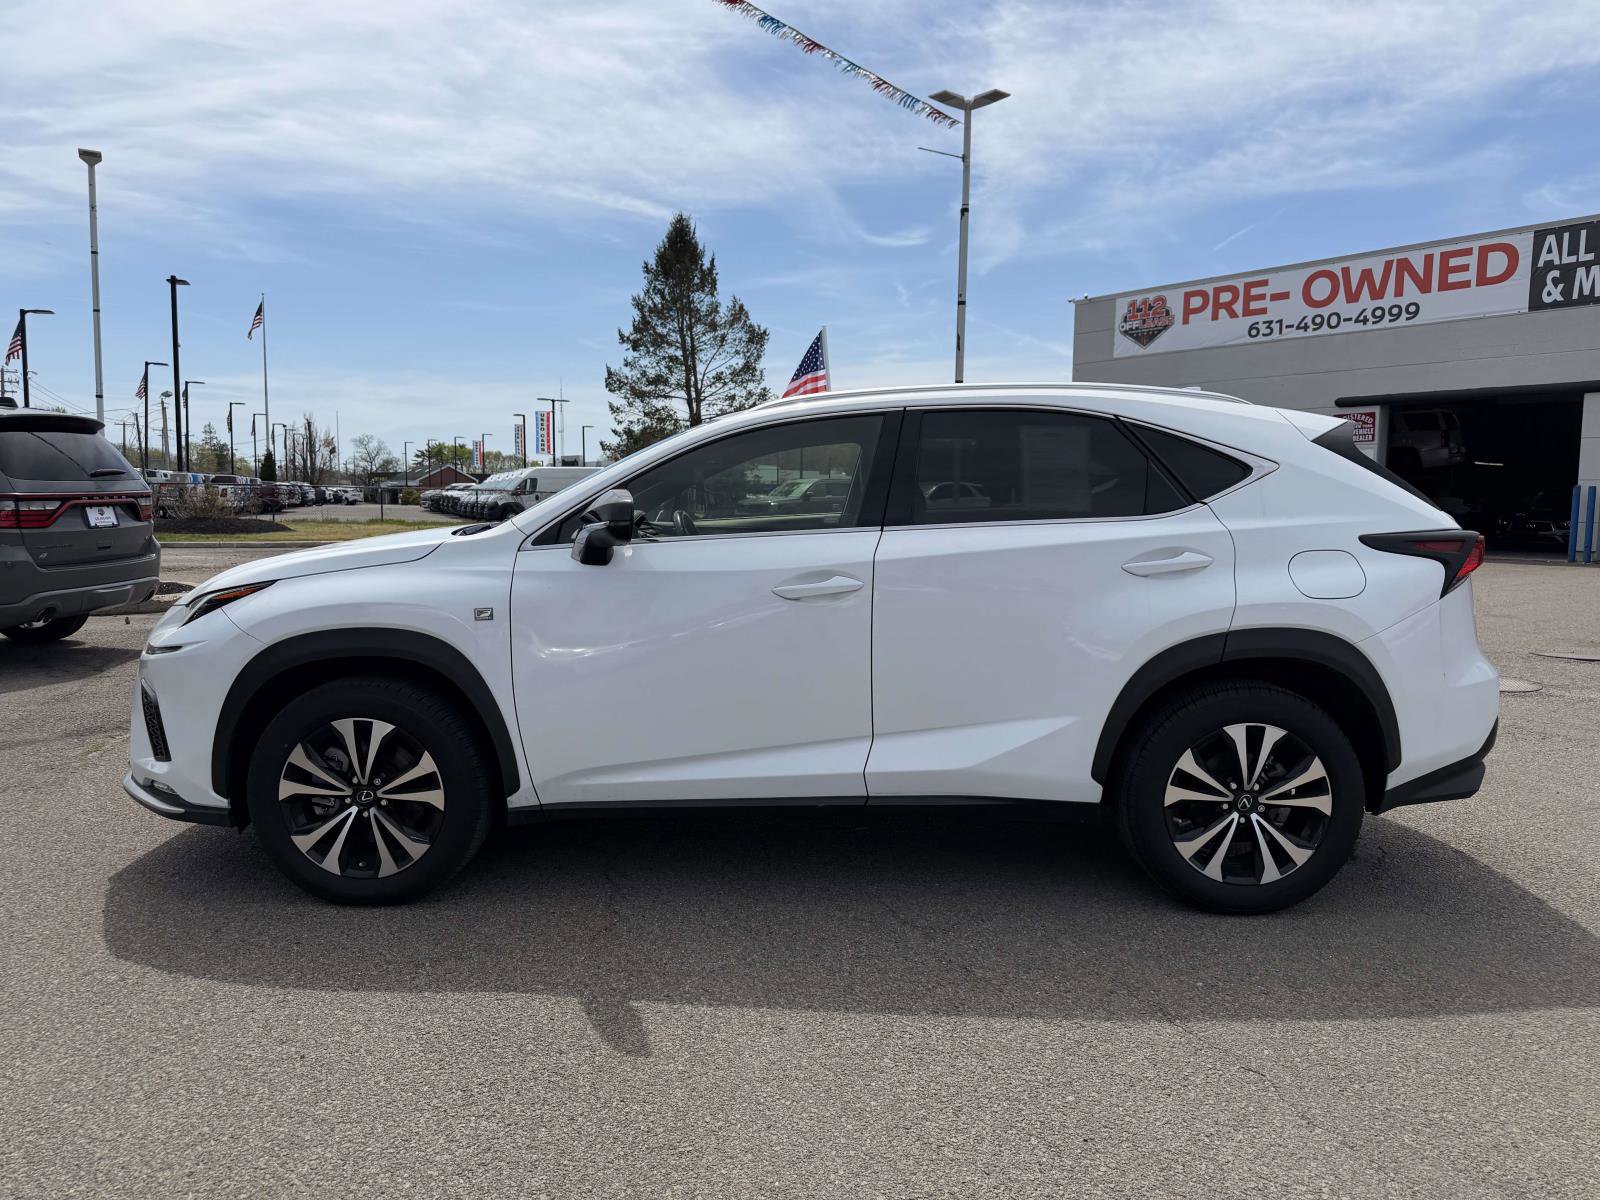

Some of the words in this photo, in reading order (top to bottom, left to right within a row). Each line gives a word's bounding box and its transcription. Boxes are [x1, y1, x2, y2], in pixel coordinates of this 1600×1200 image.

[1537, 229, 1595, 267] ALL
[1302, 242, 1520, 308] OWNED
[1541, 269, 1565, 304] &
[1127, 295, 1168, 320] 112
[1247, 301, 1421, 338] 631-490-4999
